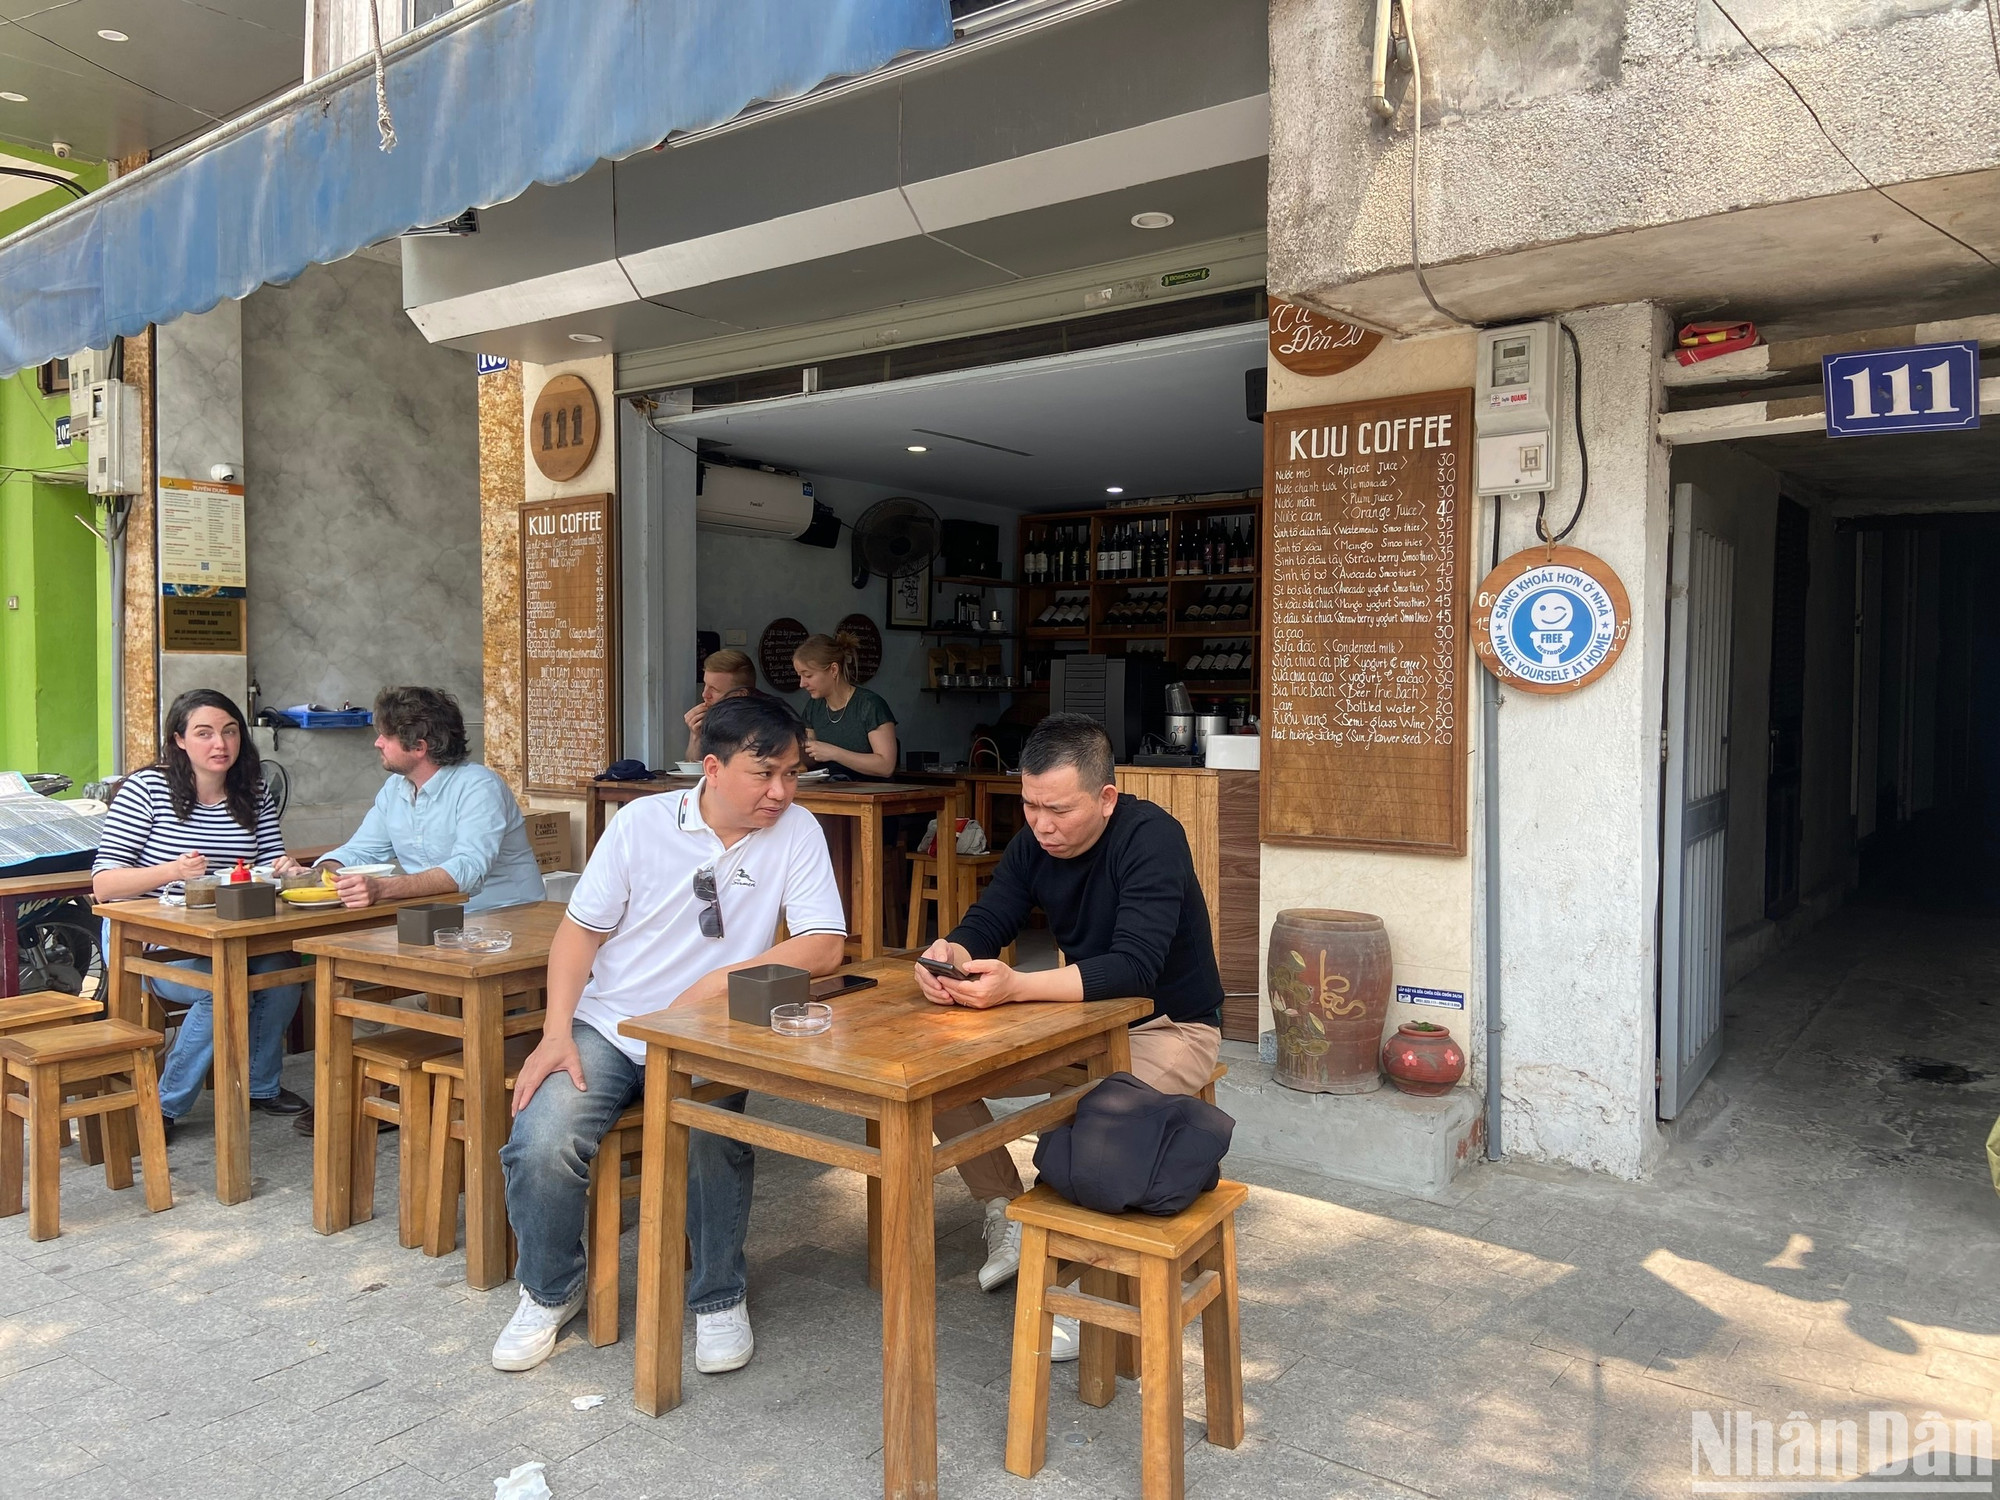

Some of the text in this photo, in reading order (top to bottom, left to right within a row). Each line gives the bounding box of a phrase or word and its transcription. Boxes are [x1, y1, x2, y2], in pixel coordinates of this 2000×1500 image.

[1843, 360, 1960, 420] 111
[541, 405, 583, 451] 111
[1290, 415, 1452, 461] KUU COFFEE
[1437, 453, 1455, 466] 30
[1437, 468, 1456, 482] 30
[1437, 484, 1454, 498] 30
[529, 511, 602, 535] KUU COFFEE
[1437, 516, 1453, 529] 35
[1437, 530, 1454, 545] 35
[1438, 545, 1454, 561] 35
[1436, 562, 1453, 576] 45
[1436, 576, 1453, 592] 55
[1434, 594, 1451, 607] 45
[1516, 570, 1554, 592] KHOÁI
[1557, 573, 1584, 588] HƠN
[1590, 592, 1612, 617] NHÀ
[1436, 609, 1451, 623] 45
[1434, 625, 1454, 639] 30
[1540, 633, 1563, 644] FREE
[1433, 640, 1454, 655] 30
[1536, 644, 1566, 655] RESTROOM
[1295, 655, 1316, 667] chua
[1433, 655, 1453, 669] 30
[1495, 635, 1518, 666] MAKE
[1515, 662, 1570, 682] YOURSELF
[1572, 661, 1587, 677] AT
[1585, 633, 1611, 667] HOME
[1435, 670, 1454, 684] 30
[1271, 683, 1288, 696] Bia
[1437, 684, 1453, 700] 25
[1436, 701, 1453, 715] 20
[1435, 715, 1454, 729] 50
[1435, 728, 1453, 745] 20
